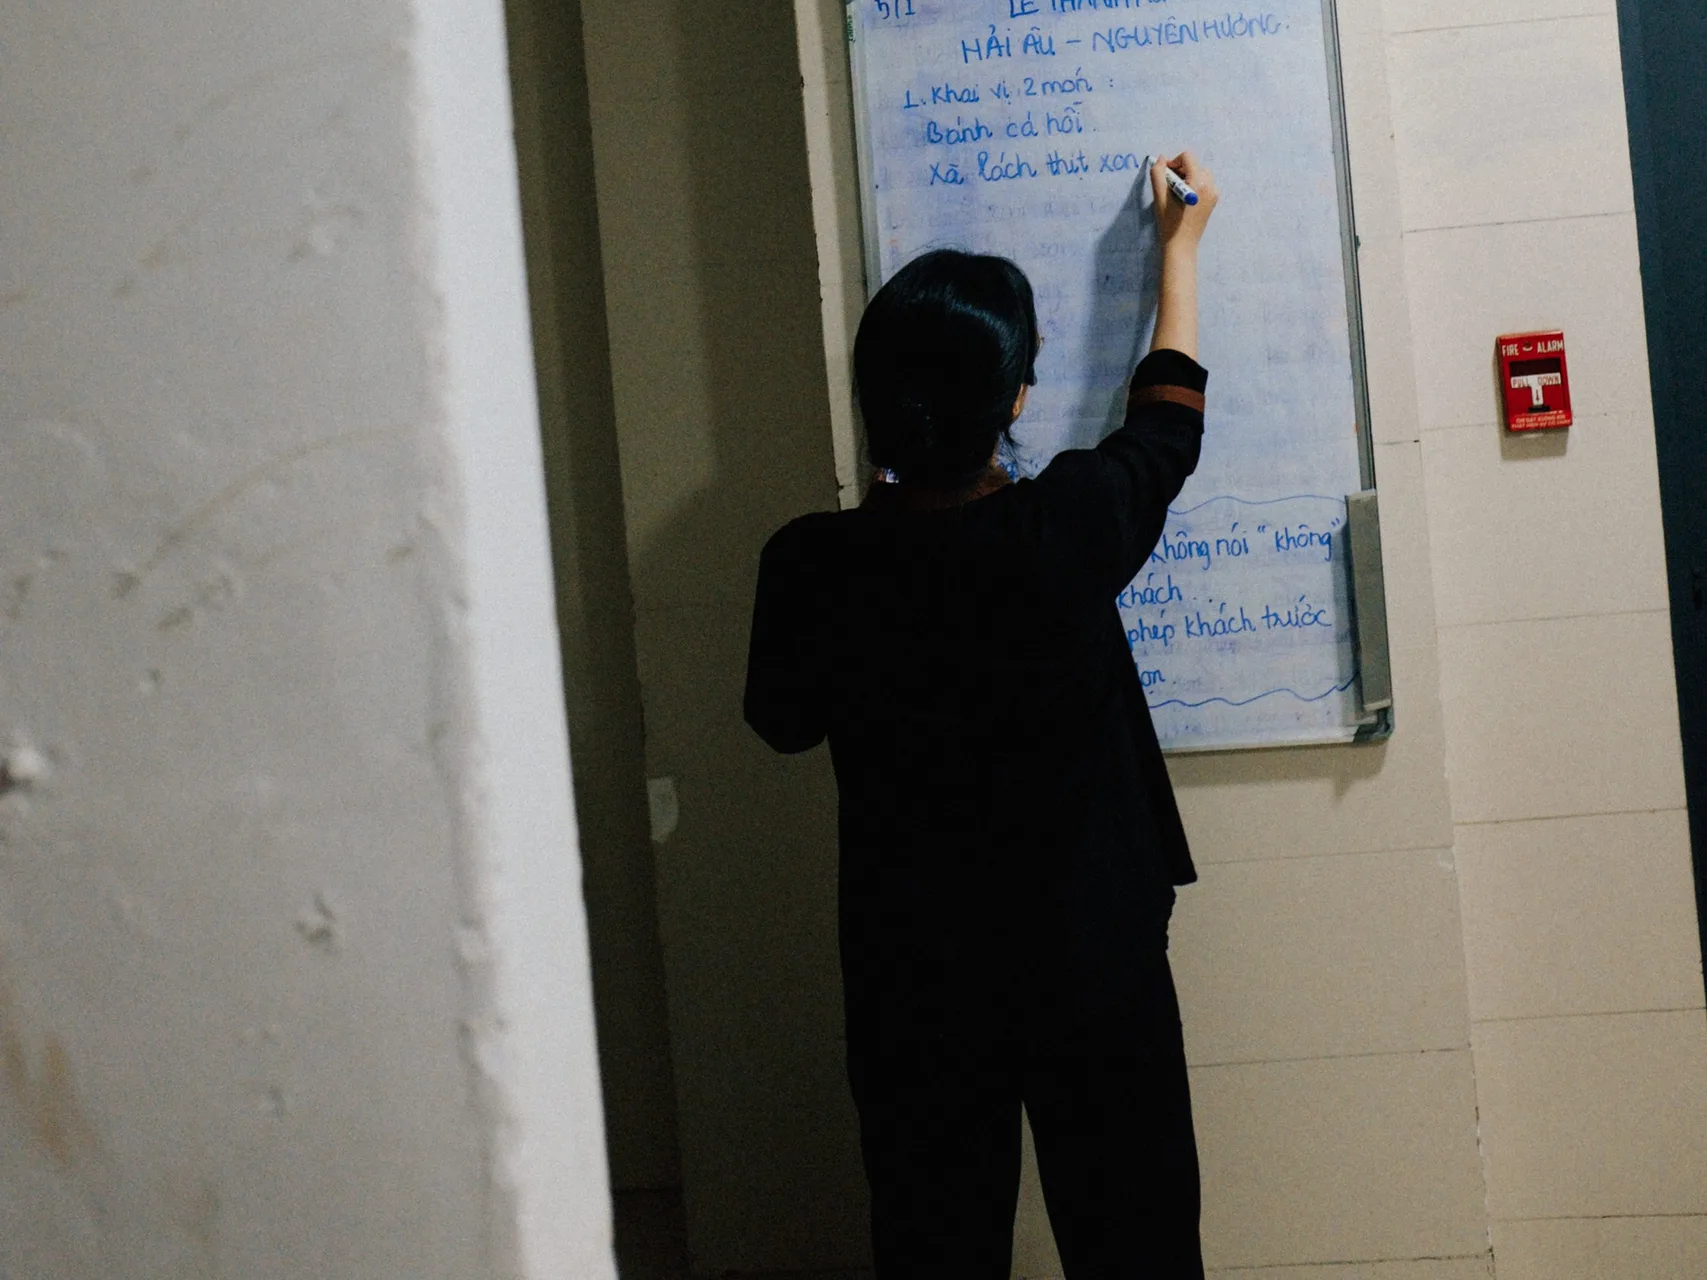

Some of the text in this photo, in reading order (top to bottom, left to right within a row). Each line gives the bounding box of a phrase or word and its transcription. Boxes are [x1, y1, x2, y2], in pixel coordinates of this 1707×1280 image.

[1023, 77, 1037, 97] 2
[926, 116, 993, 145] Bánh
[1006, 111, 1039, 138] cá
[1502, 339, 1564, 356] FIRE ALARM
[1215, 521, 1249, 557] nói
